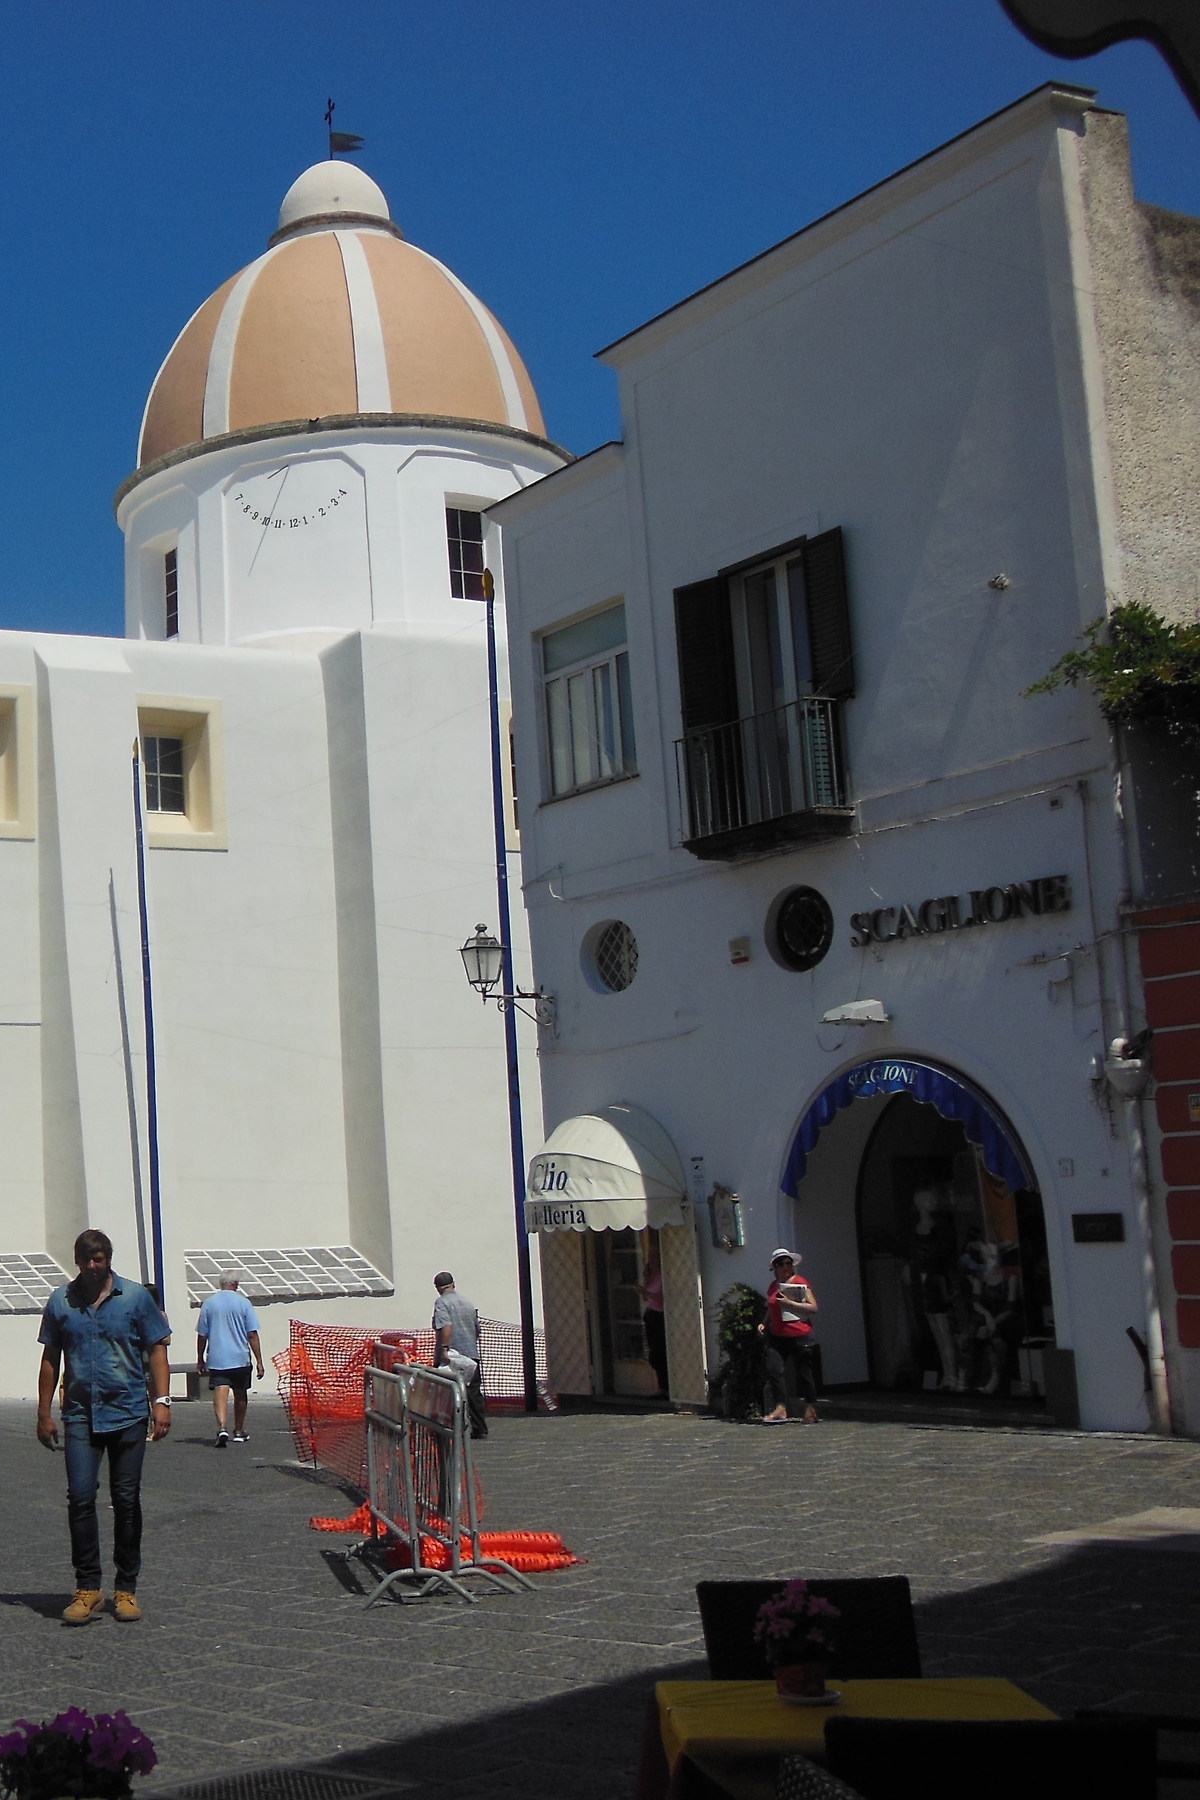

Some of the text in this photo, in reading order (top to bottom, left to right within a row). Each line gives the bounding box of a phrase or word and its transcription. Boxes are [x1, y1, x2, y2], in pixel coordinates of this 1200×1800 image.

[243, 505, 251, 513] 8
[252, 512, 259, 520] 9
[262, 517, 271, 526] 10
[274, 520, 282, 528] 11
[289, 519, 299, 528] 12
[302, 516, 308, 525] 1
[318, 508, 326, 516] 2
[331, 498, 339, 506] 3
[850, 873, 1073, 948] SCAGLIONE
[532, 1162, 568, 1193] Clio
